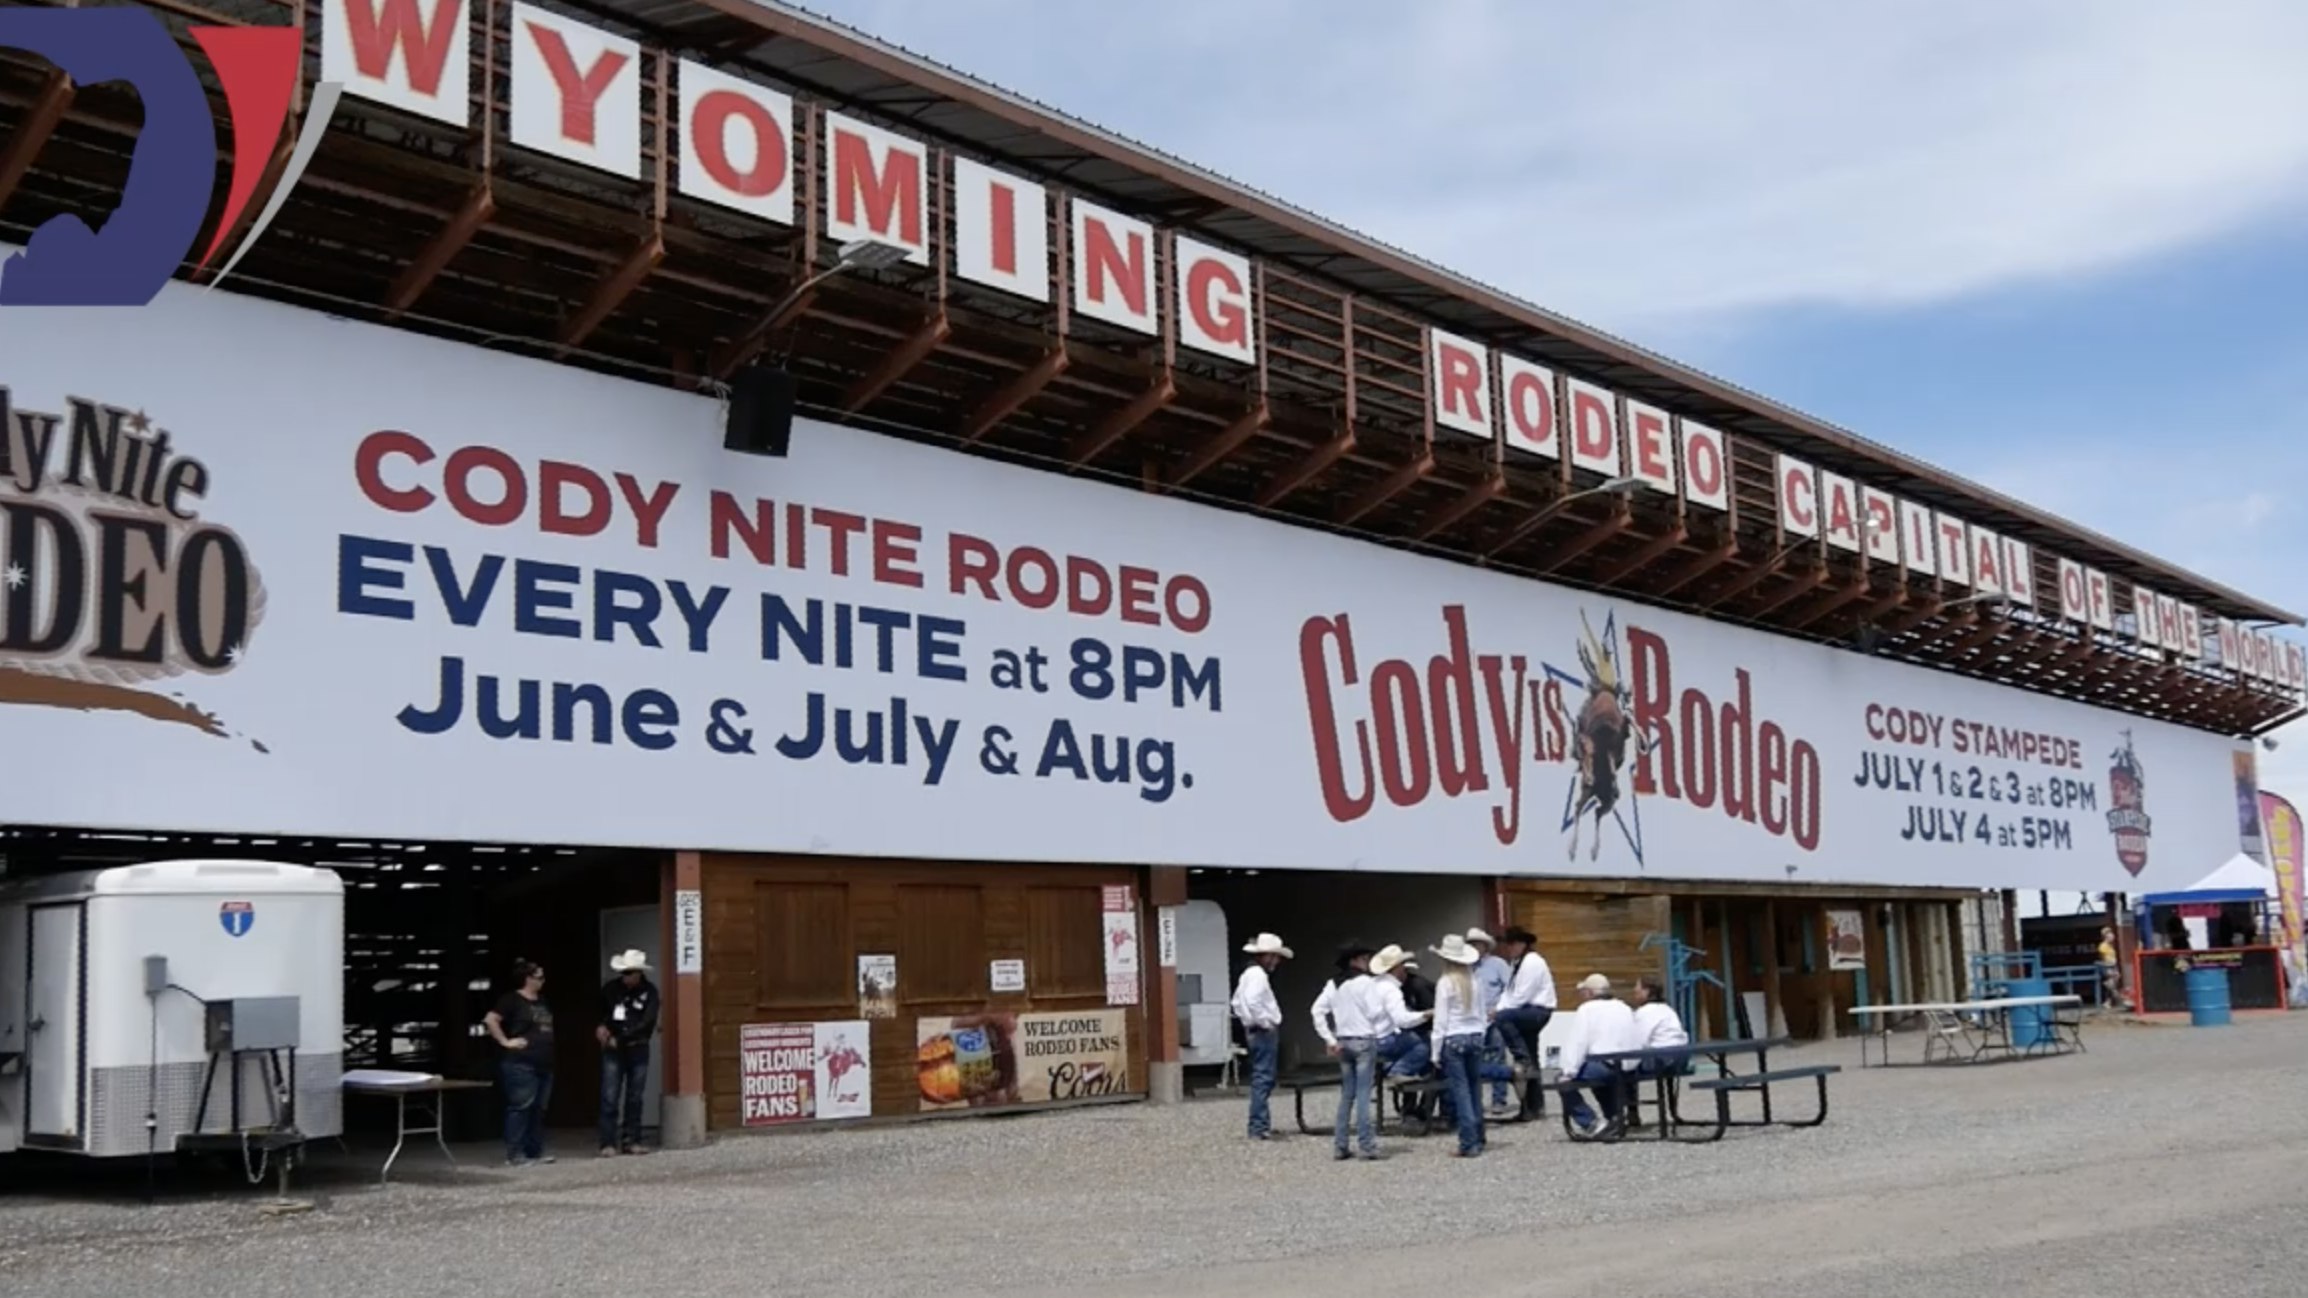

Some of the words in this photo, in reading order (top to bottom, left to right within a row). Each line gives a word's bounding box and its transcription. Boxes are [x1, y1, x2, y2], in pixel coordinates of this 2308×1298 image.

[344, 0, 1247, 350] WYOMING
[1438, 342, 1723, 497] RODEO
[1784, 467, 2026, 595] CAPITAL
[2064, 567, 2108, 618] OF
[2136, 591, 2198, 650] THE
[64, 396, 208, 520] Nite
[355, 430, 681, 548] CODY
[710, 489, 924, 588] NITE
[949, 532, 1212, 633] RODEO
[338, 534, 731, 653] EVERY
[761, 591, 967, 682] NITE
[990, 646, 1048, 693] at
[1069, 637, 1222, 712] 8PM
[396, 656, 680, 751] June
[705, 698, 757, 755] &
[775, 692, 960, 785] July
[980, 725, 1019, 776] &
[1035, 719, 1194, 802] Aug.
[1300, 604, 1527, 845] Cody
[1528, 679, 1567, 763] IS
[1626, 625, 1821, 852] Rodeo
[1865, 703, 1944, 748] CODY
[1953, 718, 2083, 769] STAMPEDE
[1854, 751, 1925, 792] JULY
[1931, 762, 1944, 796] 1
[1950, 771, 1963, 798] &
[1968, 766, 1984, 800] 2
[1989, 775, 2002, 802] &
[2006, 771, 2021, 805] 3
[2026, 782, 2045, 807] at
[2049, 776, 2097, 812] 8PM
[1901, 805, 1967, 844] JULY
[1974, 813, 1992, 845] 4
[1998, 822, 2018, 848] at
[2022, 816, 2073, 850] 5PM
[1023, 1018, 1102, 1037] WELCOME
[1024, 1039, 1077, 1057] RODEO
[1080, 1036, 1120, 1054] FANS
[744, 1048, 814, 1074] WELCOME
[745, 1073, 797, 1096] RODEO
[746, 1095, 799, 1119] FANS
